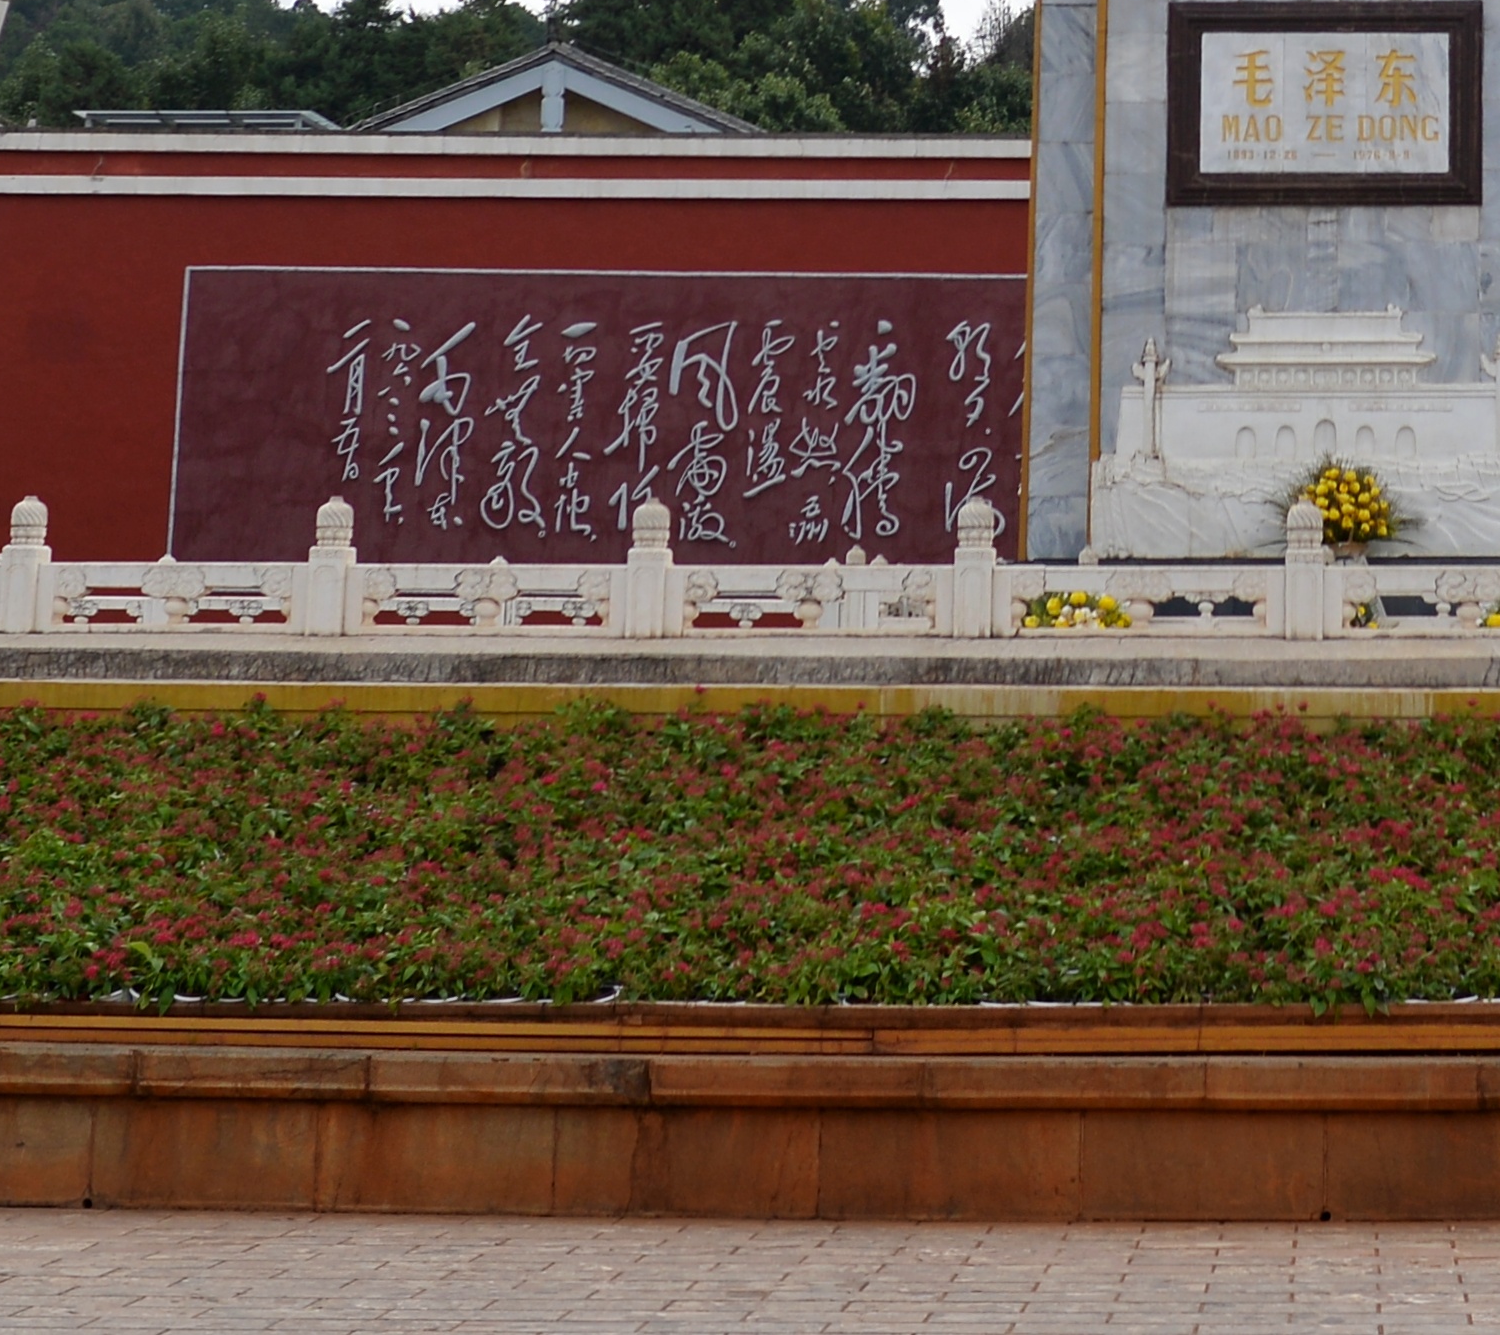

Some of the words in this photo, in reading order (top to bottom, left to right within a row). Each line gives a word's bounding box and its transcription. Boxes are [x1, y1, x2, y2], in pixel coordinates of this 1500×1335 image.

[1233, 49, 1418, 108] 毛泽东
[1221, 114, 1283, 143] MAO
[1305, 114, 1345, 142] ZE
[1356, 114, 1440, 142] DONG
